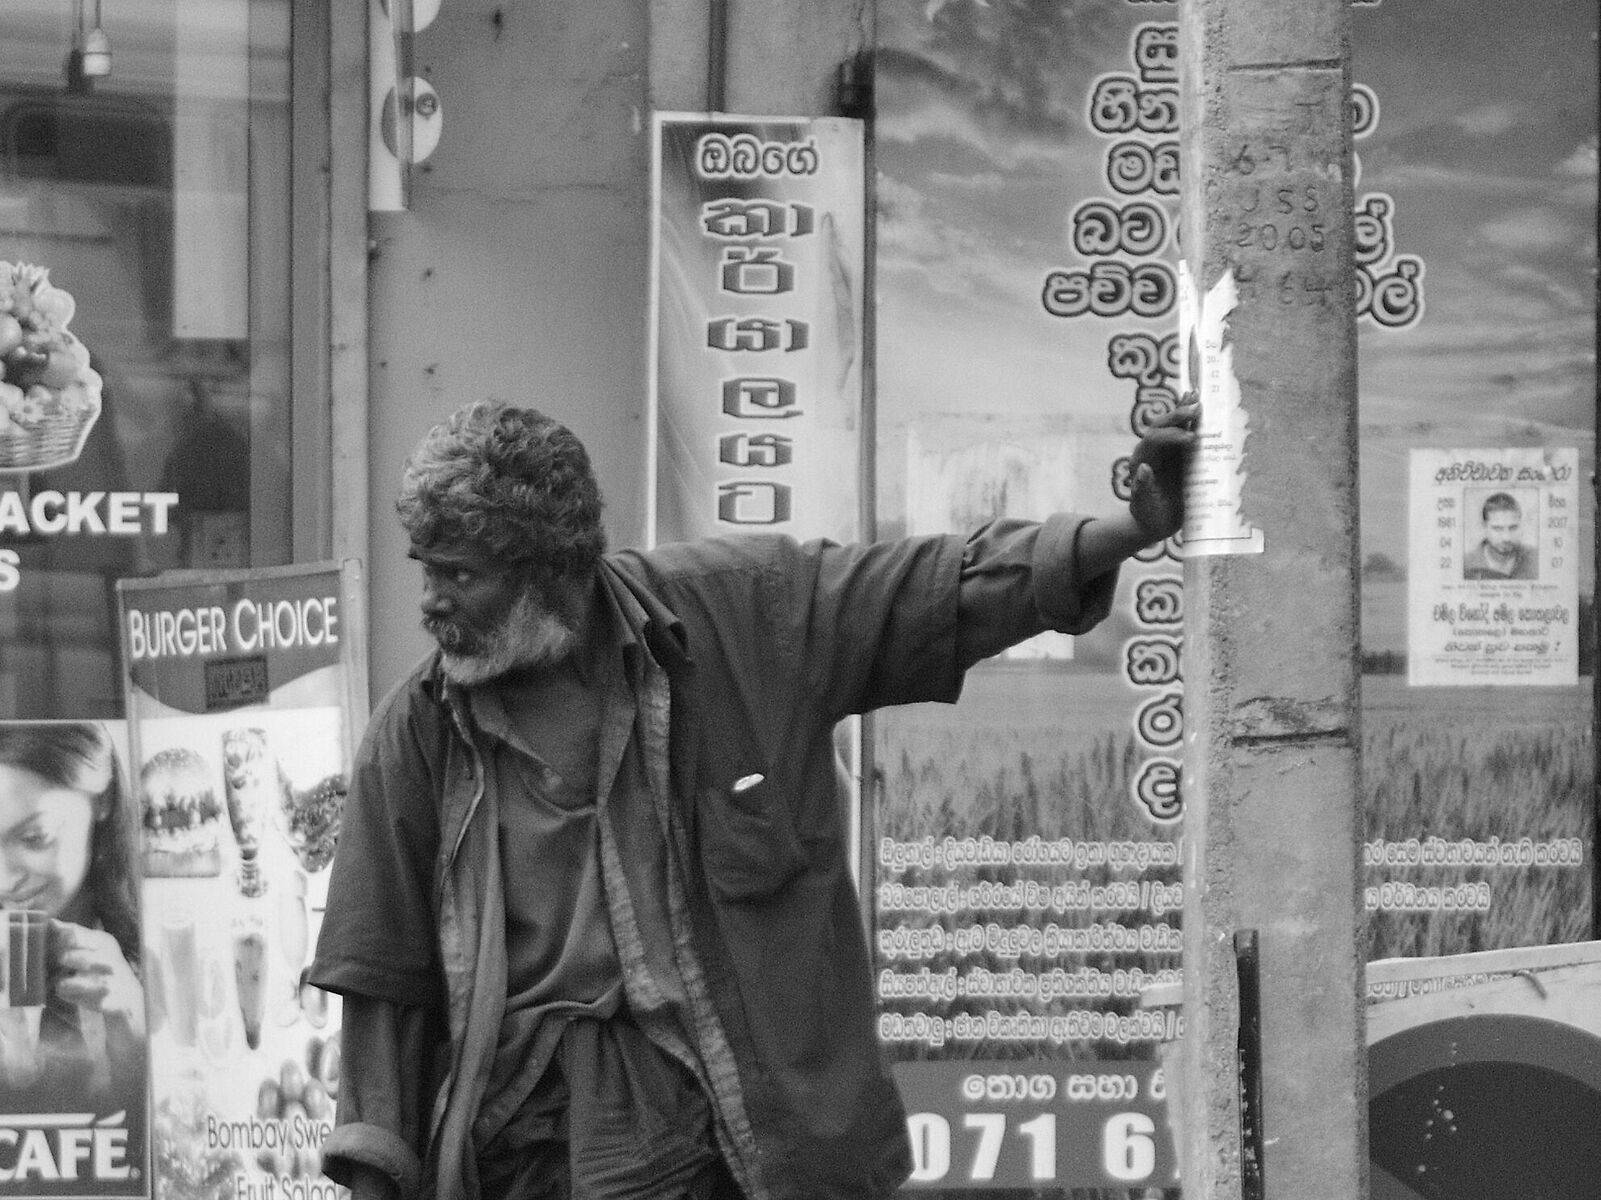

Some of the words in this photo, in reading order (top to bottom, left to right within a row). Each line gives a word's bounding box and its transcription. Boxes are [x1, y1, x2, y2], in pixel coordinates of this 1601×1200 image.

[700, 135, 818, 176] ඔබගේ
[1236, 223, 1325, 251] 2005
[0, 490, 179, 533] ACKET
[129, 606, 227, 659] BURGER
[234, 597, 338, 650] CHOICE
[208, 1115, 288, 1156] Bombay
[294, 1115, 332, 1148] Swe
[906, 1112, 1058, 1182] 071
[1103, 1112, 1180, 1182] 6
